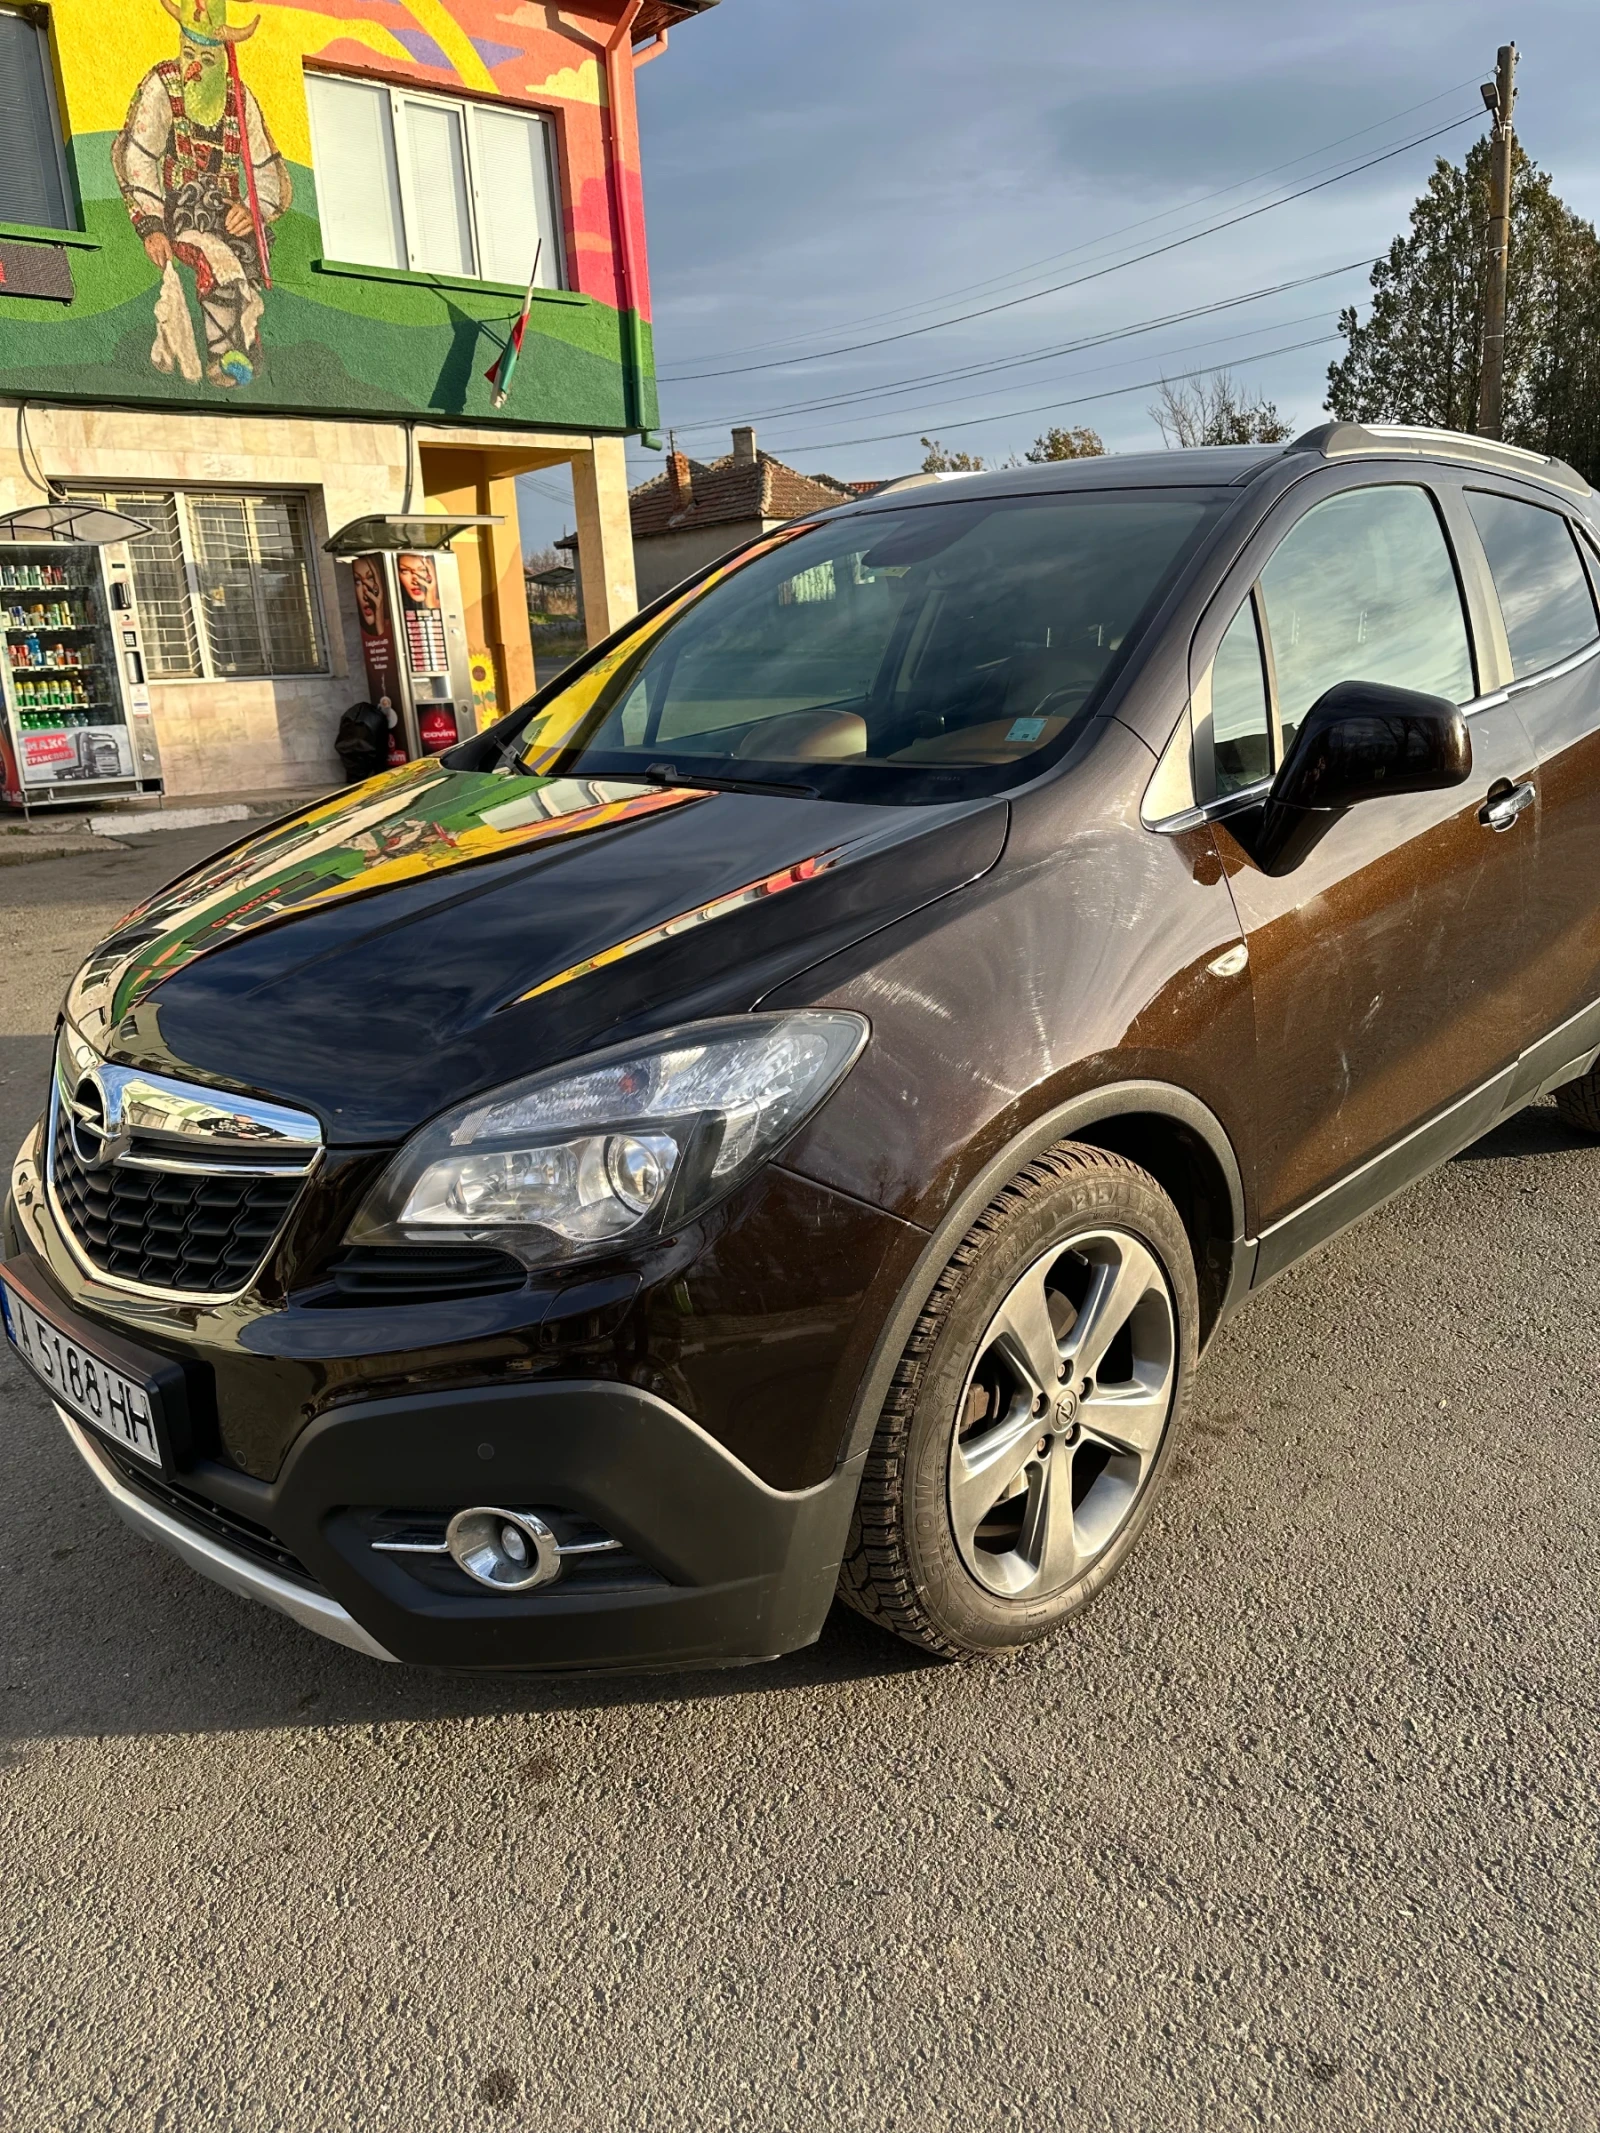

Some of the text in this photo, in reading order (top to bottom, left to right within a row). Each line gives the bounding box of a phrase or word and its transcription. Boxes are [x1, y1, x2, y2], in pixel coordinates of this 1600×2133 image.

[25, 738, 67, 751] МАКС
[423, 730, 456, 738] covim
[35, 1318, 104, 1419] 5188
[103, 1370, 157, 1453] HH
[914, 1473, 943, 1584] SNOW
